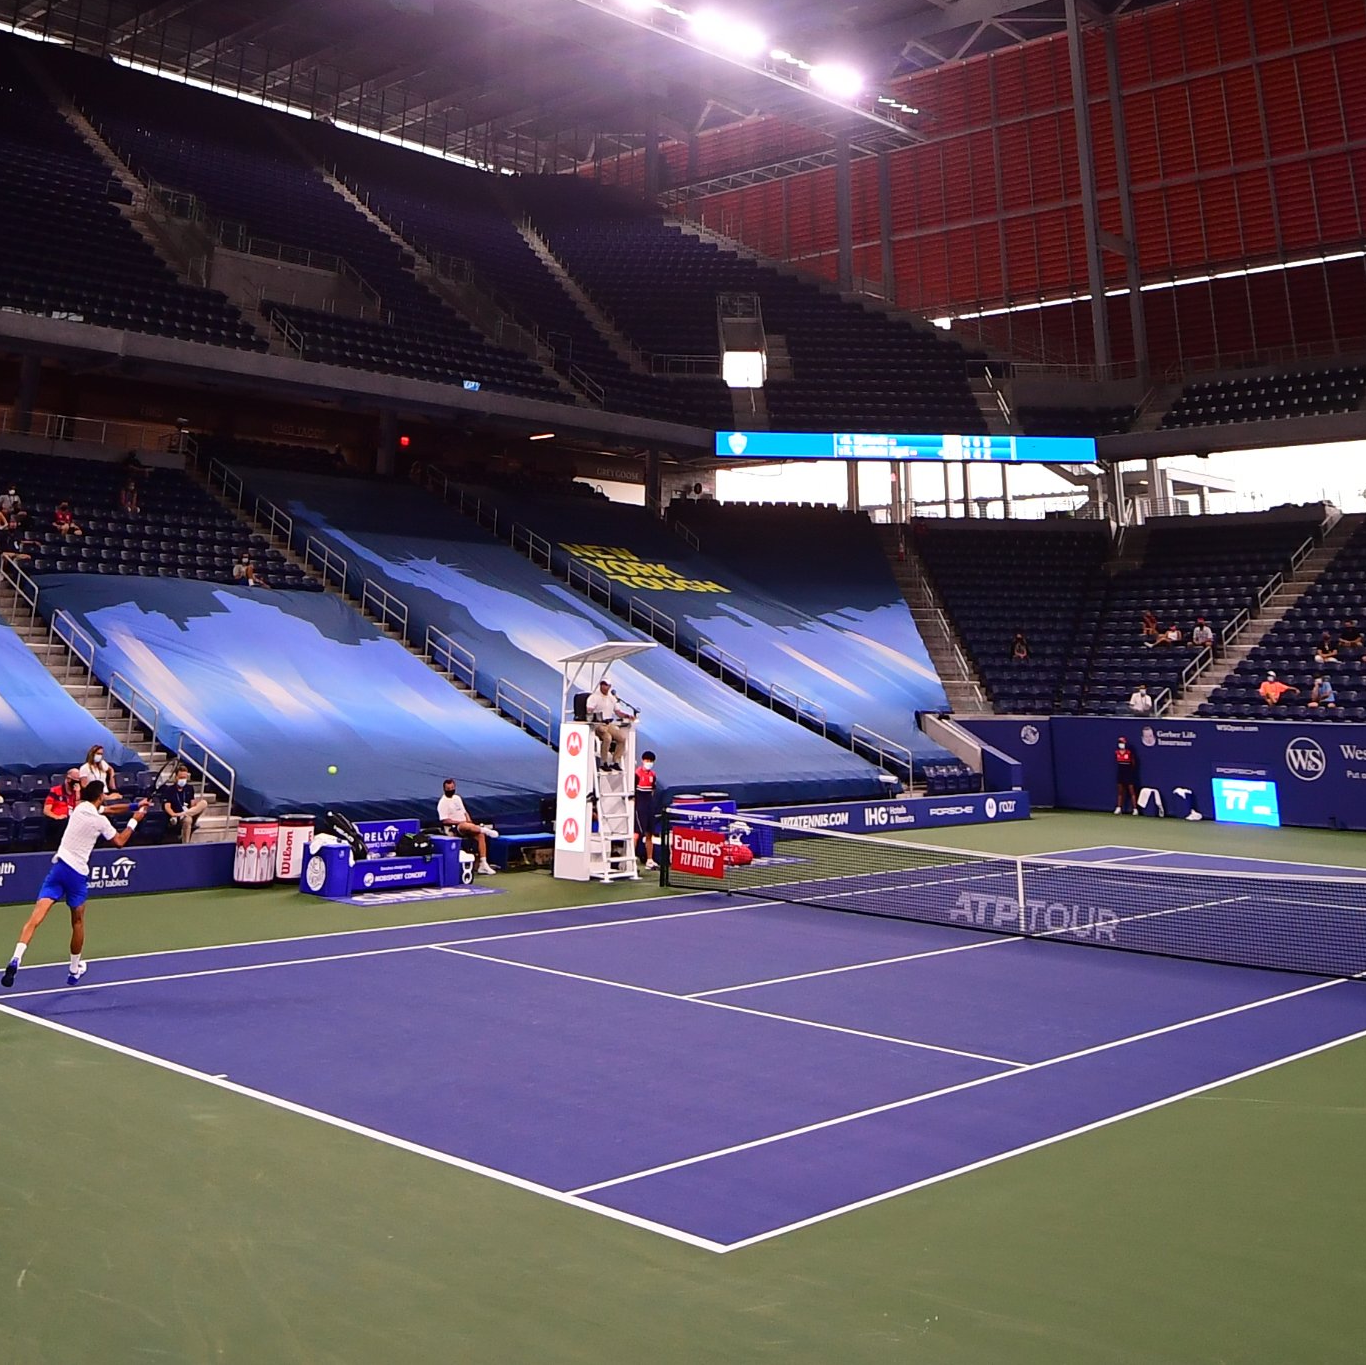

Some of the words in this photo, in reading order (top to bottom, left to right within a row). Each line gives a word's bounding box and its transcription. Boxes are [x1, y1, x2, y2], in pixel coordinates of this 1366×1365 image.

[557, 542, 641, 562] NEW
[580, 558, 686, 579] YORK
[606, 574, 732, 593] TOUGH
[1157, 730, 1181, 739] Gerber
[1182, 731, 1197, 740] Life
[1216, 724, 1259, 732] WSOpen.com
[1157, 739, 1193, 747] Insurance
[1288, 747, 1323, 772] W&S
[1216, 767, 1266, 776] PORSCHE
[1346, 770, 1360, 779] Put
[999, 800, 1016, 813] razr
[1222, 789, 1250, 811] 77
[865, 806, 888, 826] IHG
[930, 805, 974, 816] PORSCHE
[363, 831, 398, 843] RELVY
[674, 835, 722, 857] Emirates
[281, 830, 294, 876] Wilson
[680, 851, 692, 865] FLY
[692, 854, 715, 870] BETTER
[91, 865, 133, 880] ELVY
[948, 890, 1019, 927] ATP
[1026, 899, 1121, 942] TOUR
